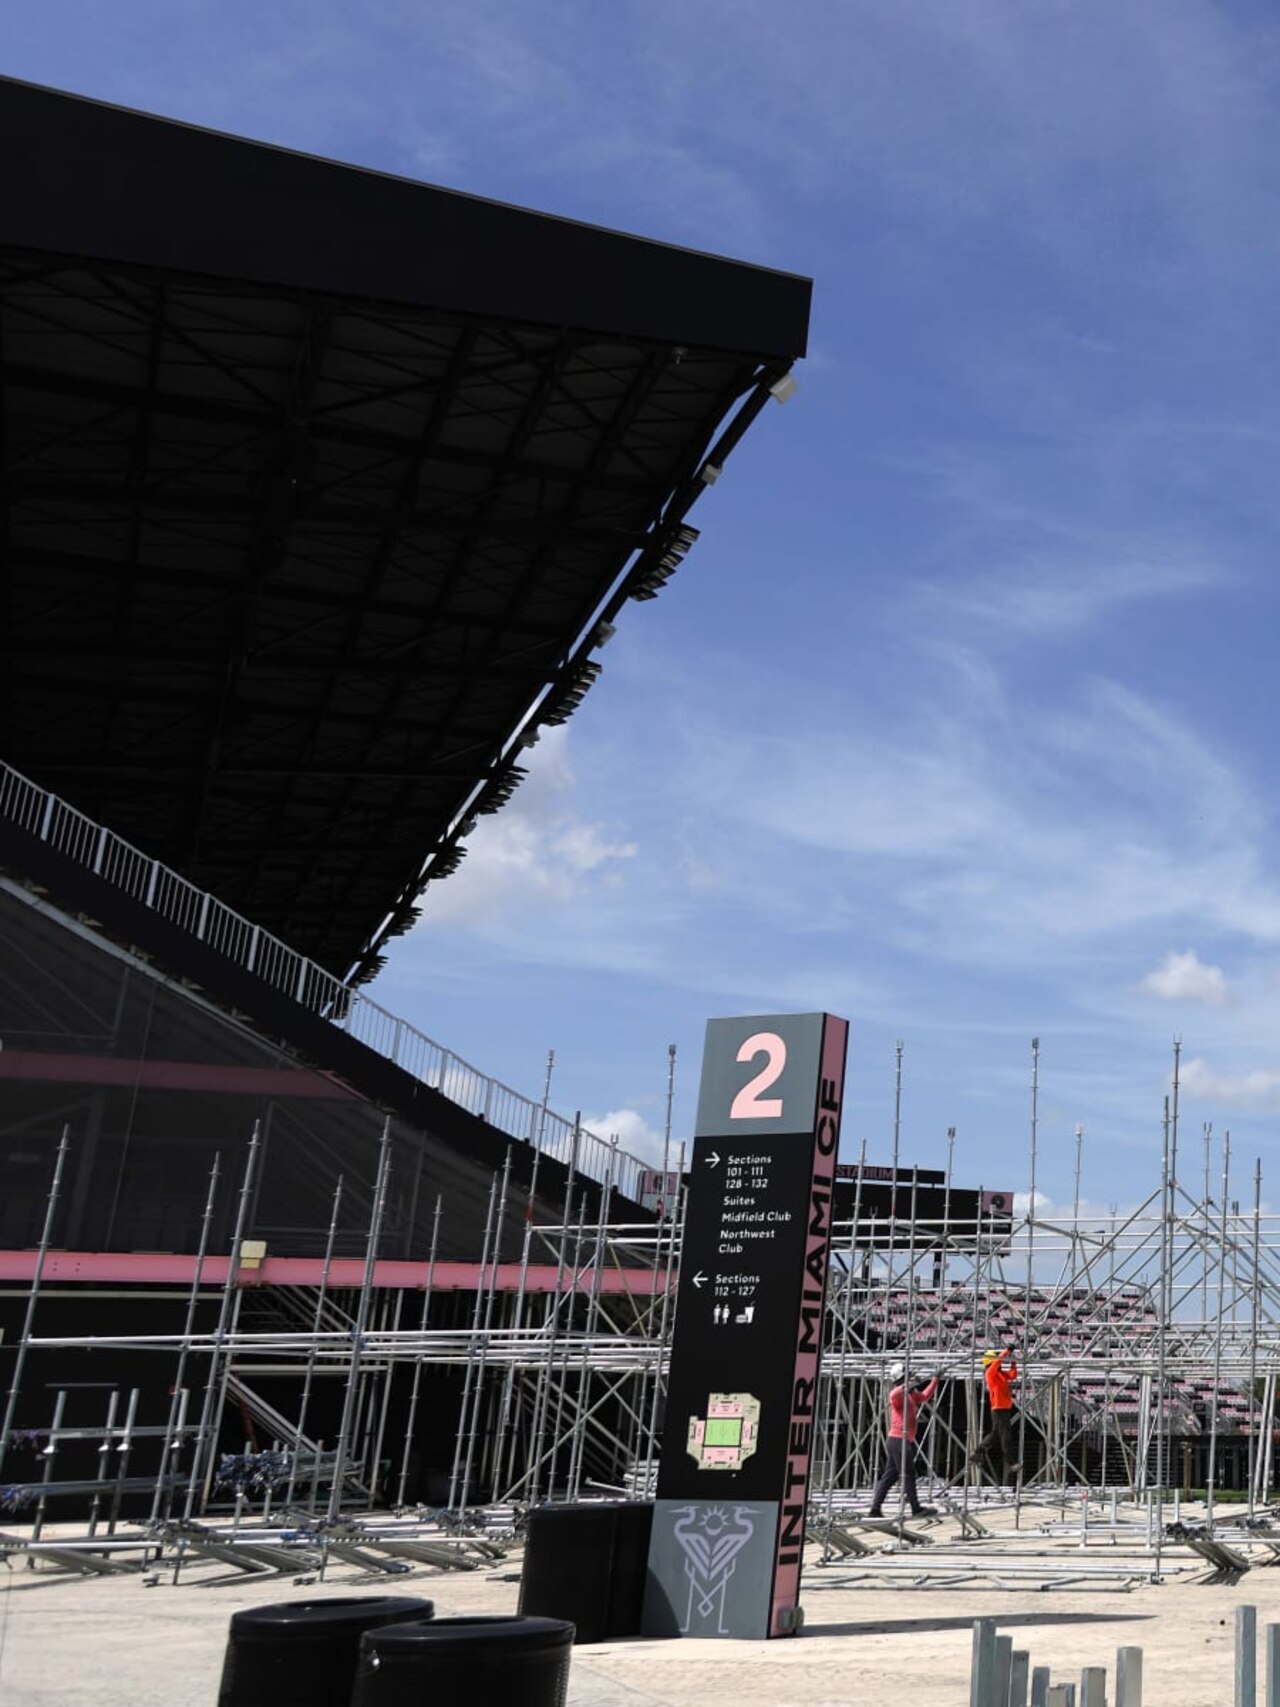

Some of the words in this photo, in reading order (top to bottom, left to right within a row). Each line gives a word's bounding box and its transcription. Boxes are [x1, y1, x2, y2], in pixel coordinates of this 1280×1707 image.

[729, 1032, 787, 1119] 2
[727, 1154, 772, 1165] Sections
[727, 1167, 742, 1176] 101
[751, 1166, 763, 1176] 111
[836, 1166, 894, 1180] STADIUM
[726, 1179, 742, 1189] 128
[751, 1178, 768, 1188] 132
[723, 1195, 755, 1206] Suites
[721, 1211, 765, 1222] Midfield
[767, 1210, 792, 1222] Club
[720, 1228, 775, 1239] Northwest
[718, 1243, 743, 1254] Club
[715, 1273, 760, 1284] Sections
[714, 1286, 729, 1296] 112
[739, 1285, 756, 1296] 127
[778, 1377, 815, 1567] INTER
[798, 1174, 831, 1354] MIAMI
[817, 1078, 839, 1156] CF
